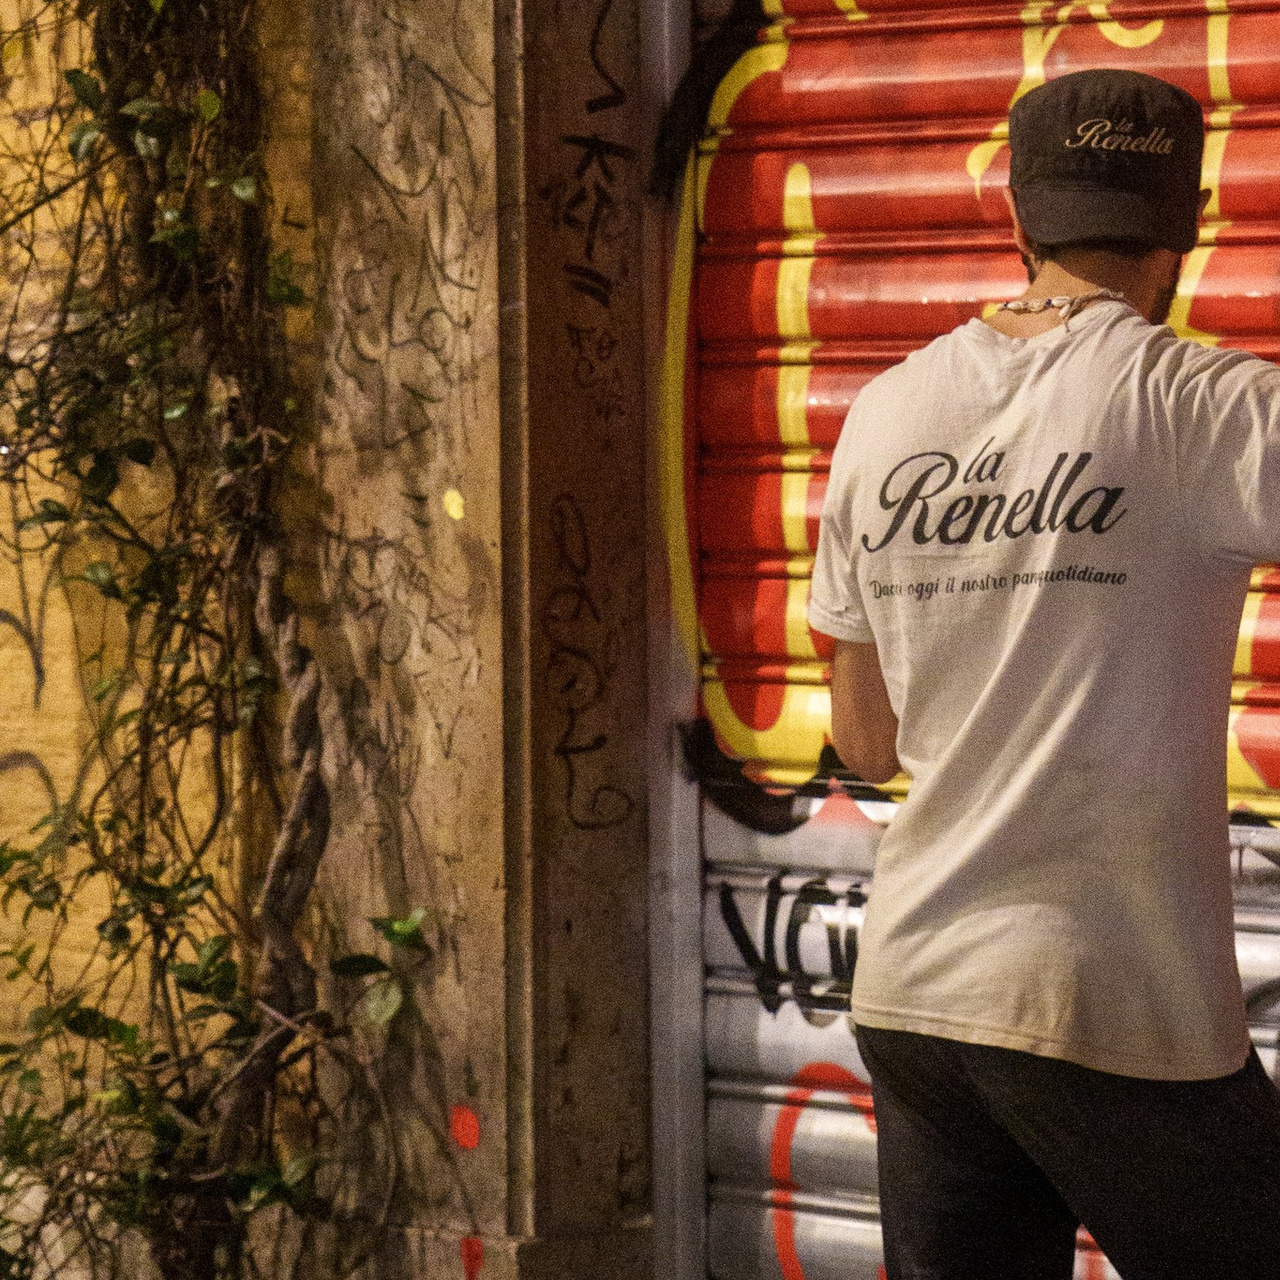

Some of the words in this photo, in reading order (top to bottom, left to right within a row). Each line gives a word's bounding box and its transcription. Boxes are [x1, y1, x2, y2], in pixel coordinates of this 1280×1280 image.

[1064, 118, 1176, 155] Renella
[1114, 116, 1135, 133] la
[963, 436, 1005, 484] la
[862, 451, 1128, 554] Renella
[907, 578, 940, 601] oggi
[945, 576, 956, 594] il
[960, 573, 1008, 592] nostro
